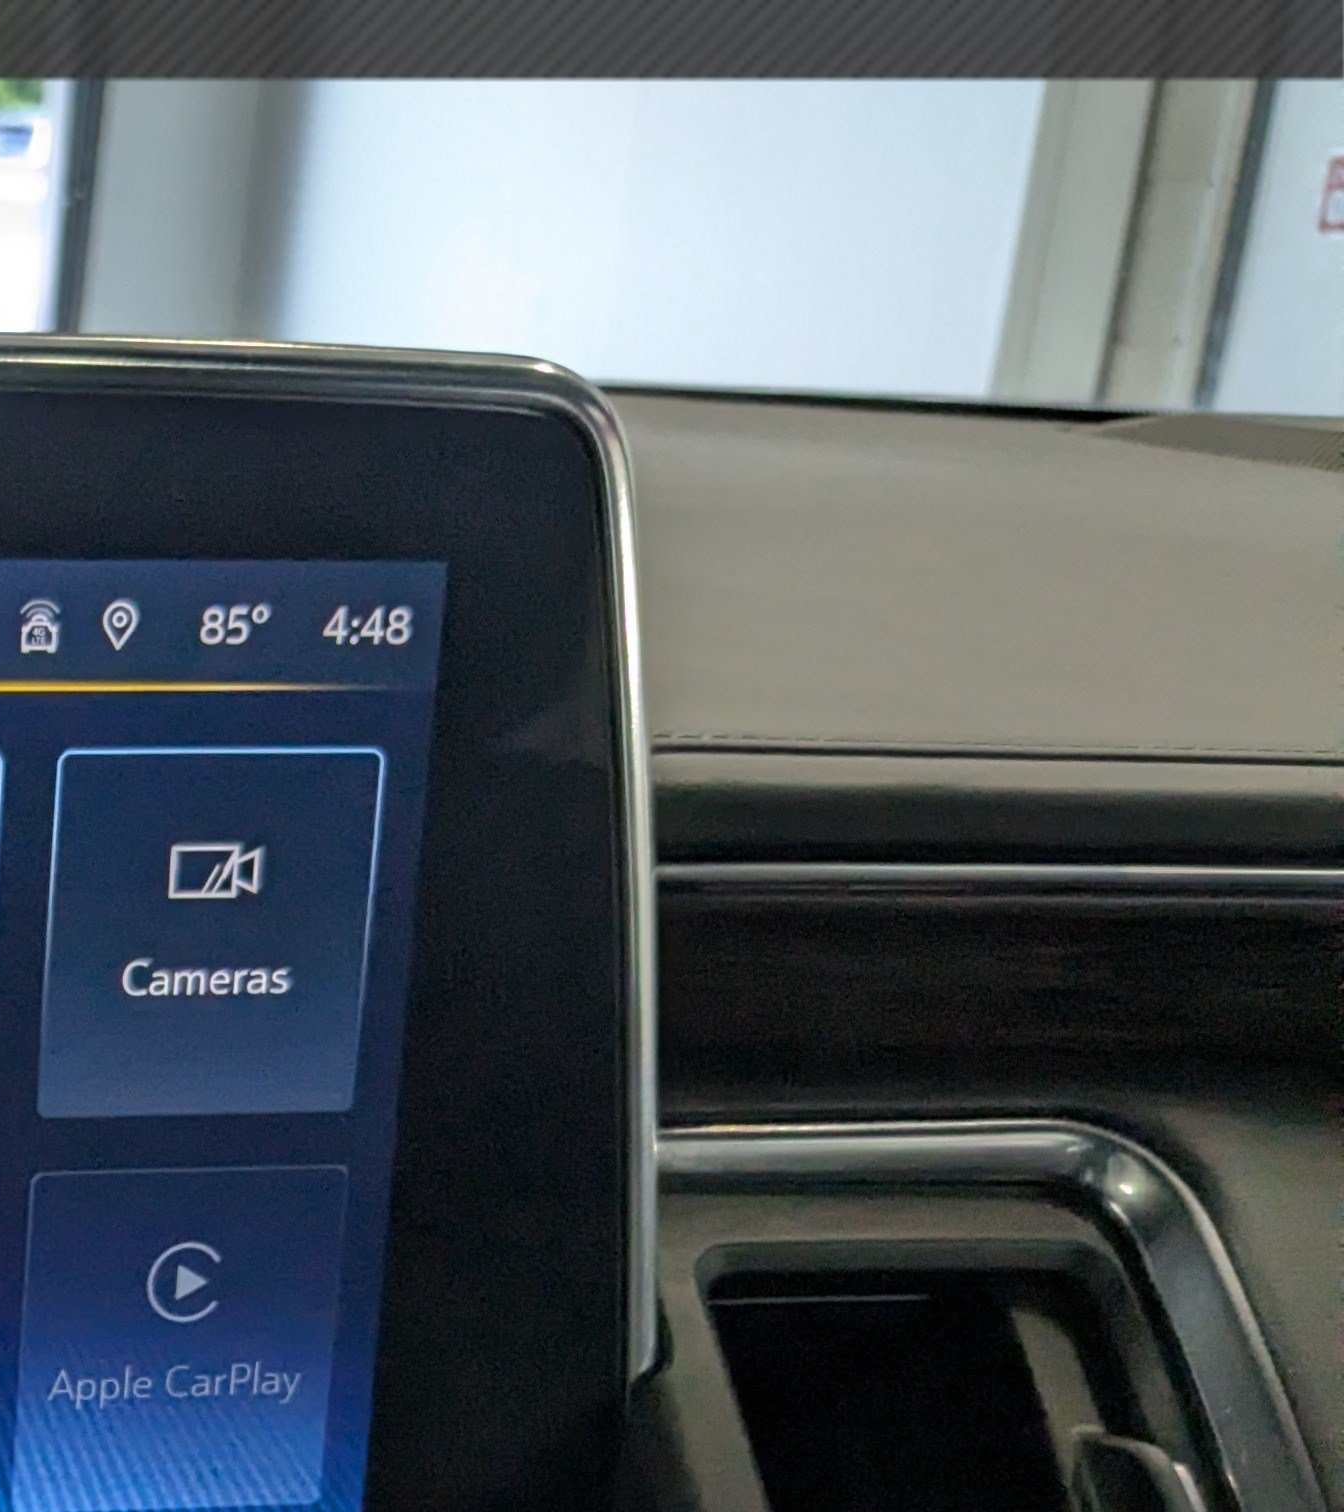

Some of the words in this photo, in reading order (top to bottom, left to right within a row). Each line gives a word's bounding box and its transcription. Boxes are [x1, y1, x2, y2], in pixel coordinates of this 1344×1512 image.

[198, 602, 272, 646] 85°
[321, 604, 413, 647] 4:48
[120, 957, 292, 998] Cameras
[46, 1364, 154, 1411] Apple
[164, 1360, 303, 1406] CarPlay
